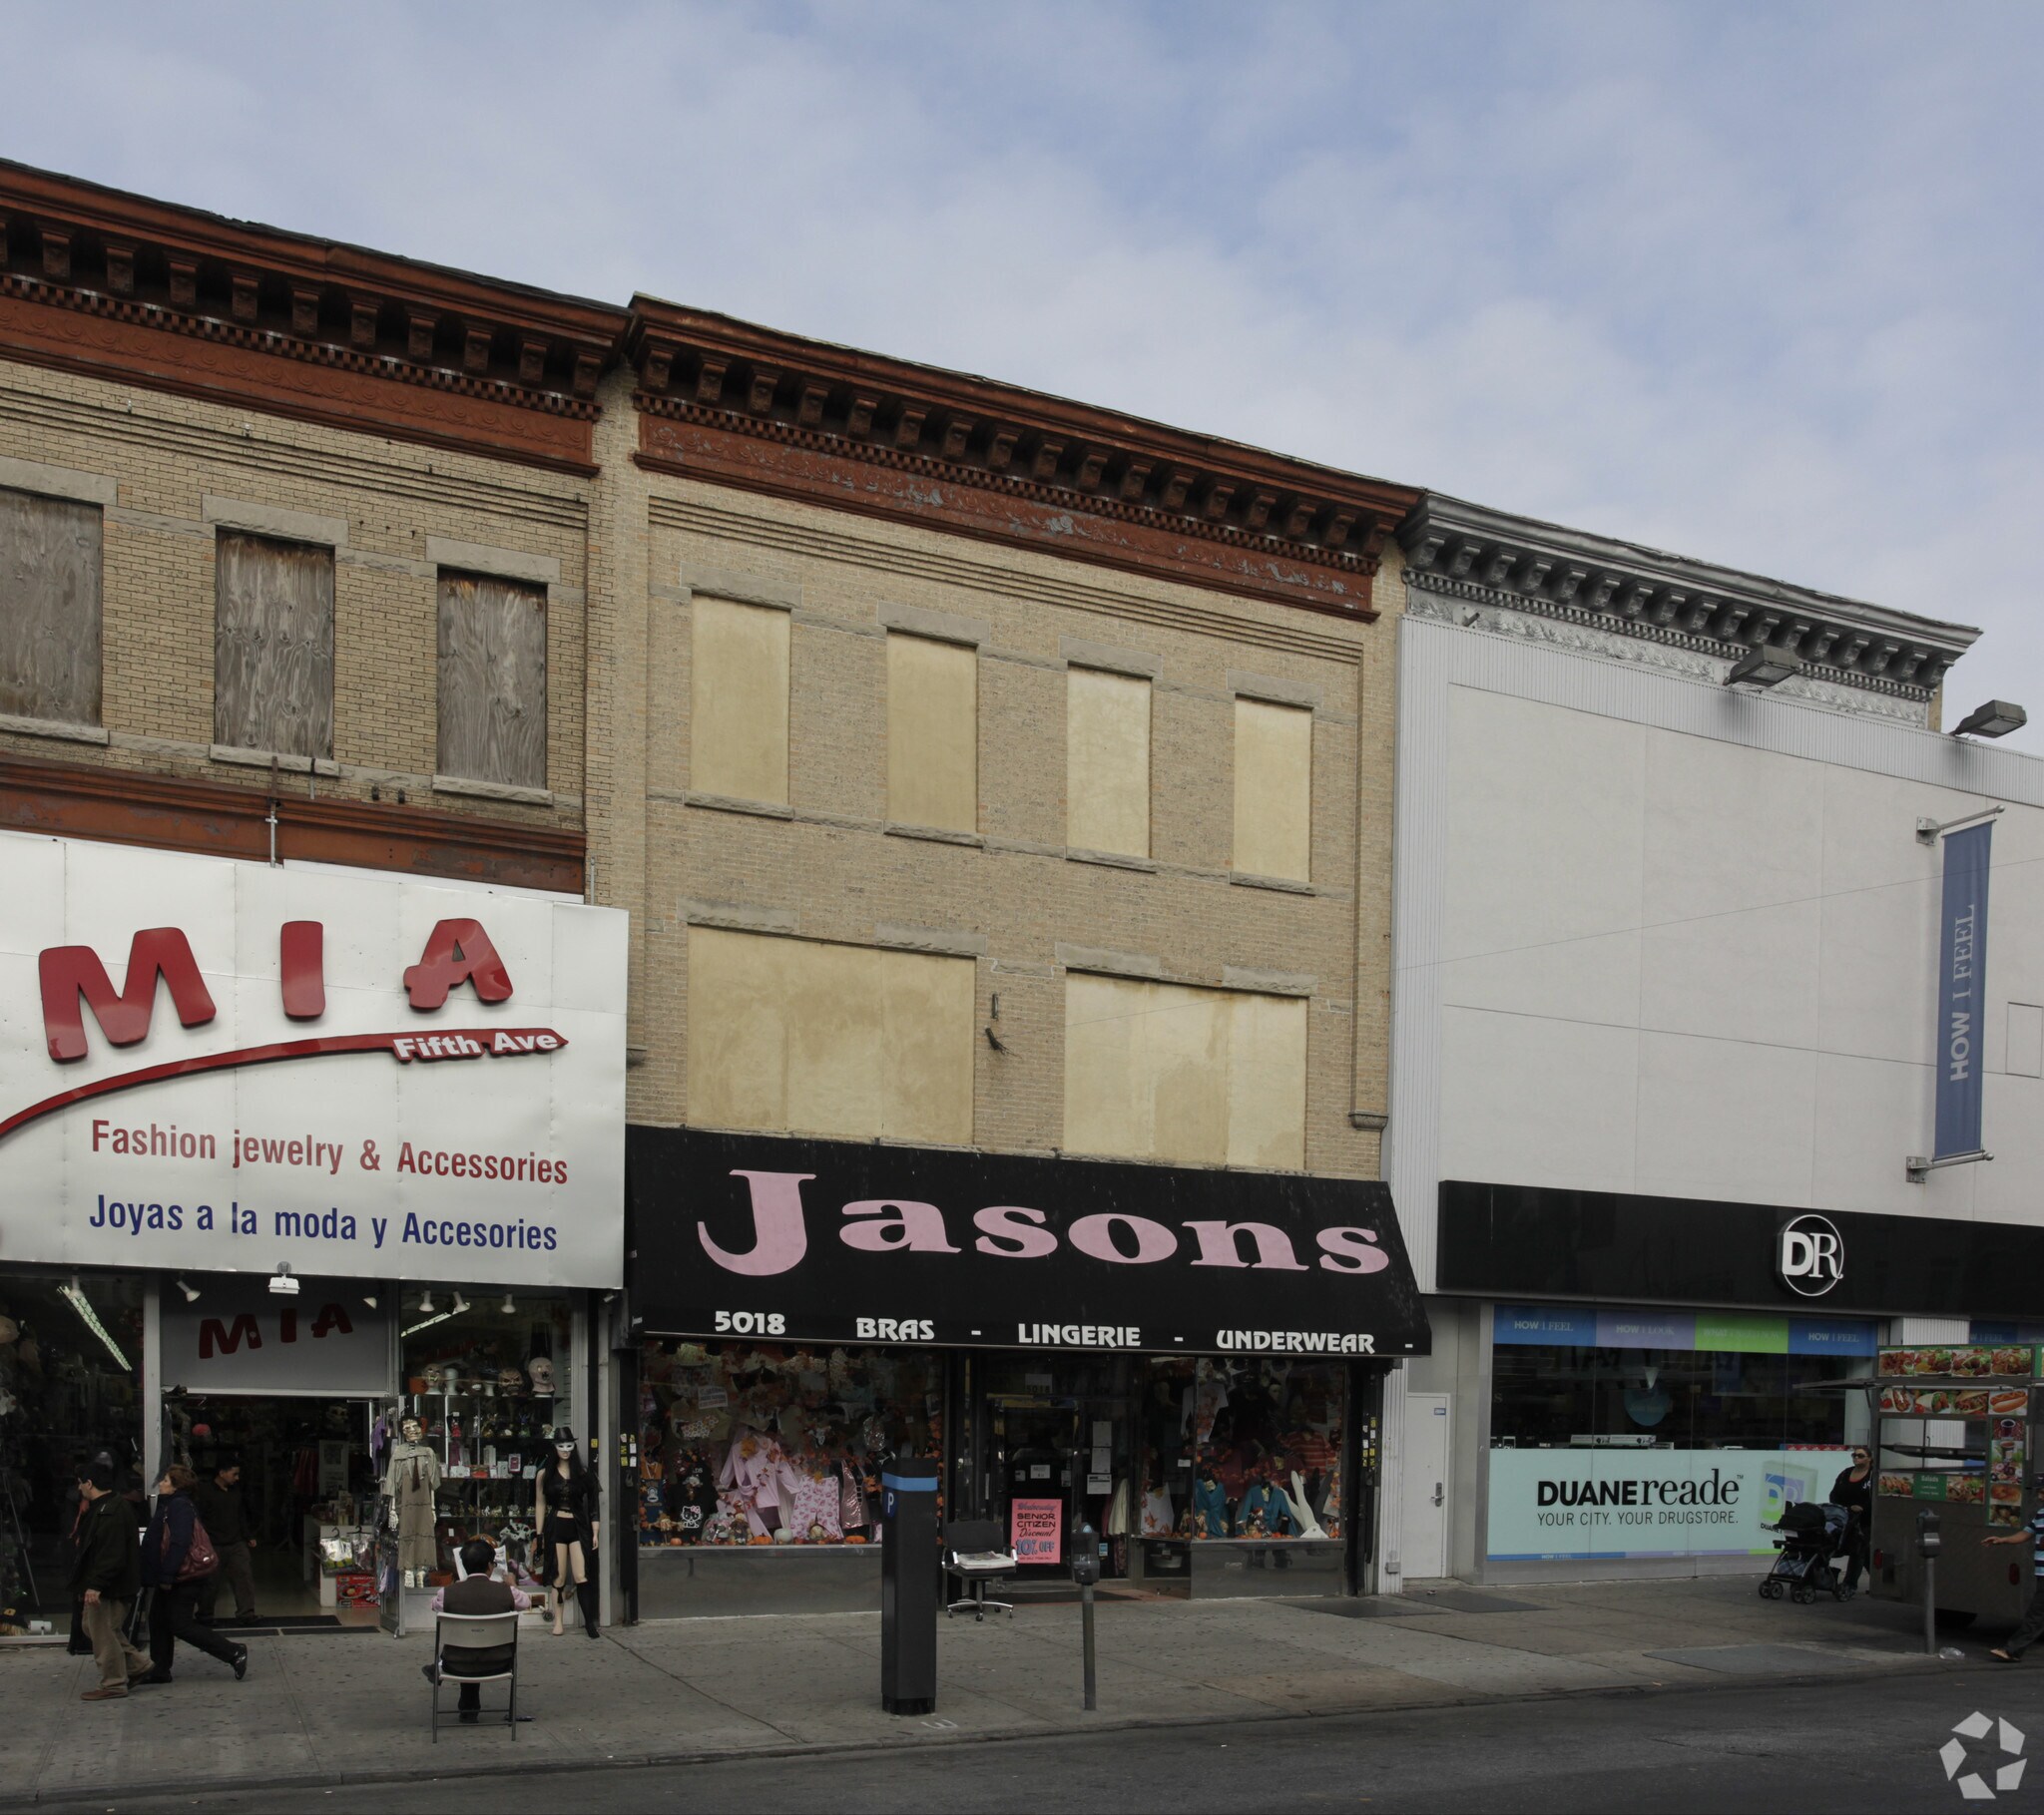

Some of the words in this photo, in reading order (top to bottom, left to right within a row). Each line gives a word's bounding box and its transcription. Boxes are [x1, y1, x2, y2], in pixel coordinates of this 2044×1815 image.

[1953, 904, 1975, 983] FEEL
[38, 917, 515, 1064] MIA
[393, 1034, 486, 1061] Fifth
[488, 1031, 560, 1055] Ave
[1950, 1011, 1971, 1082] HOW
[91, 1119, 217, 1160] Fashion
[232, 1129, 344, 1175] jewelry
[359, 1138, 382, 1171] &
[397, 1141, 569, 1185] Accessories
[90, 1194, 184, 1236] Joyas
[197, 1205, 215, 1232] a
[231, 1201, 258, 1235] la
[274, 1206, 357, 1241] moda
[371, 1216, 388, 1249] y
[402, 1212, 559, 1251] Accesories
[697, 1168, 1390, 1277] Jasons
[1782, 1230, 1844, 1279] DR
[198, 1302, 354, 1360] MIA
[714, 1310, 786, 1335] 5018
[855, 1317, 935, 1342] BRAS
[1017, 1323, 1141, 1349] LINGERIE
[1216, 1329, 1375, 1355] UNDERWEAR
[1514, 1320, 1539, 1330] HOW
[1548, 1322, 1574, 1332] FEEL
[1615, 1325, 1640, 1334] HOW
[1807, 1332, 1829, 1342] HOW
[1837, 1332, 1859, 1343] FEEL
[886, 1493, 895, 1514] P
[1538, 1512, 1574, 1526] YOUR
[1580, 1512, 1611, 1526] CITY.
[1618, 1512, 1653, 1525] YOUR
[1659, 1511, 1739, 1524] DRUGSTORE.
[1016, 1539, 1038, 1556] 10%
[1039, 1541, 1055, 1553] OFF
[1019, 1528, 1055, 1538] Discount
